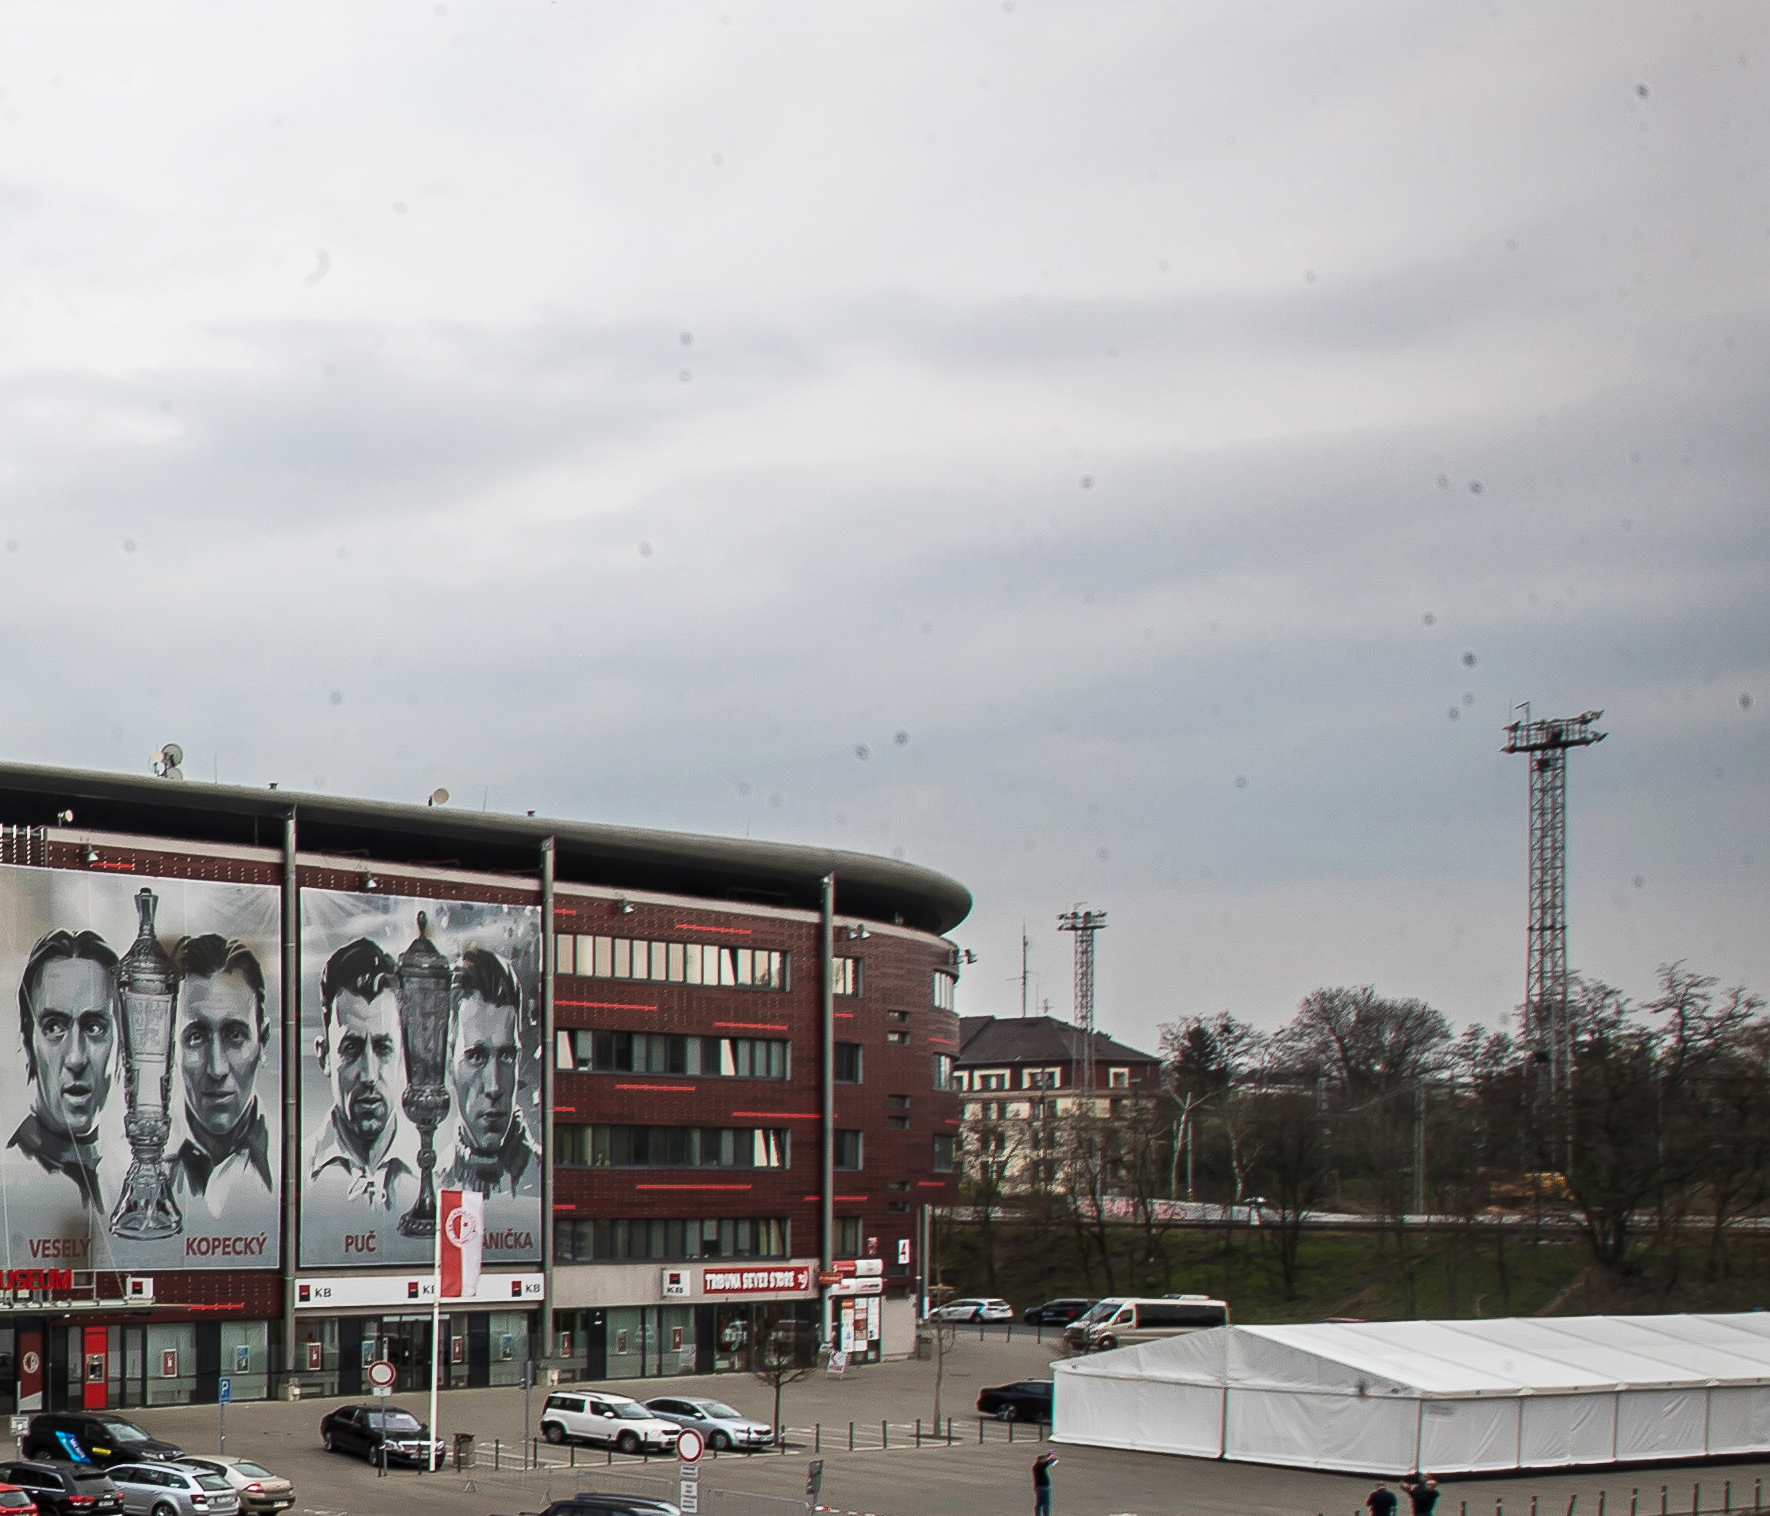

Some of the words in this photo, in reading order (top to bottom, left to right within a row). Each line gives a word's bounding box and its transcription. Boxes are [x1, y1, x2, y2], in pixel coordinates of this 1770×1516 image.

[186, 1234, 267, 1257] KOPECKÝ
[345, 1230, 377, 1254] PUČ
[315, 1288, 332, 1297] KB
[526, 1284, 540, 1293] KB
